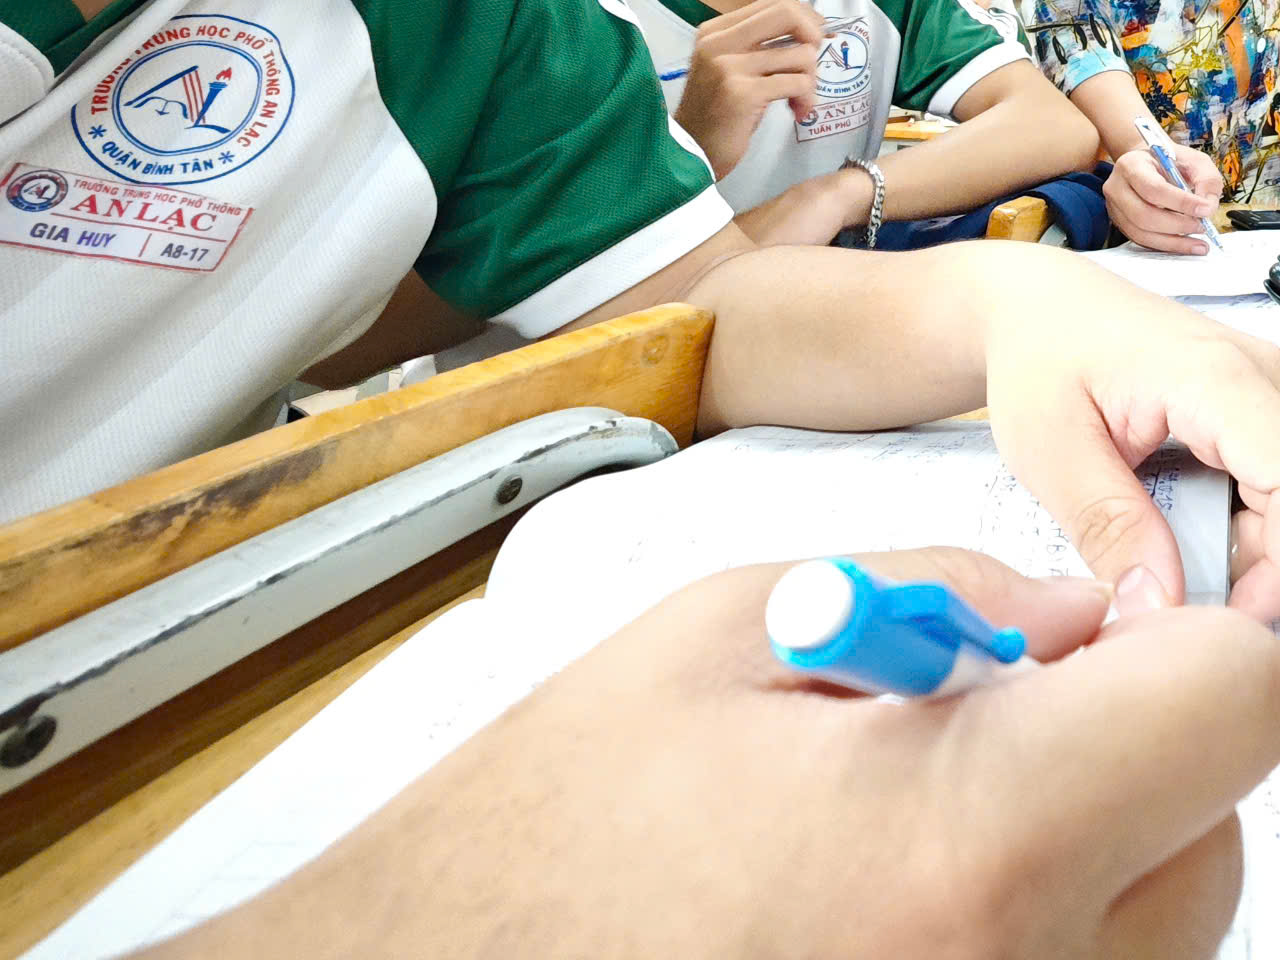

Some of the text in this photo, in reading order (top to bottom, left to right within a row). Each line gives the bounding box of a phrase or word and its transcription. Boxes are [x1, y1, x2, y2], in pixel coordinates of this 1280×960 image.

[135, 27, 191, 55] RUNG
[196, 25, 230, 40] HỌC
[260, 100, 278, 118] AN
[824, 107, 846, 119] AN
[237, 121, 268, 147] LẠC
[102, 141, 213, 175] QUẬN BÌNH TÂN
[70, 194, 217, 231] AN LẠC
[30, 223, 117, 248] GIA HUY
[161, 243, 210, 262] A8-17
